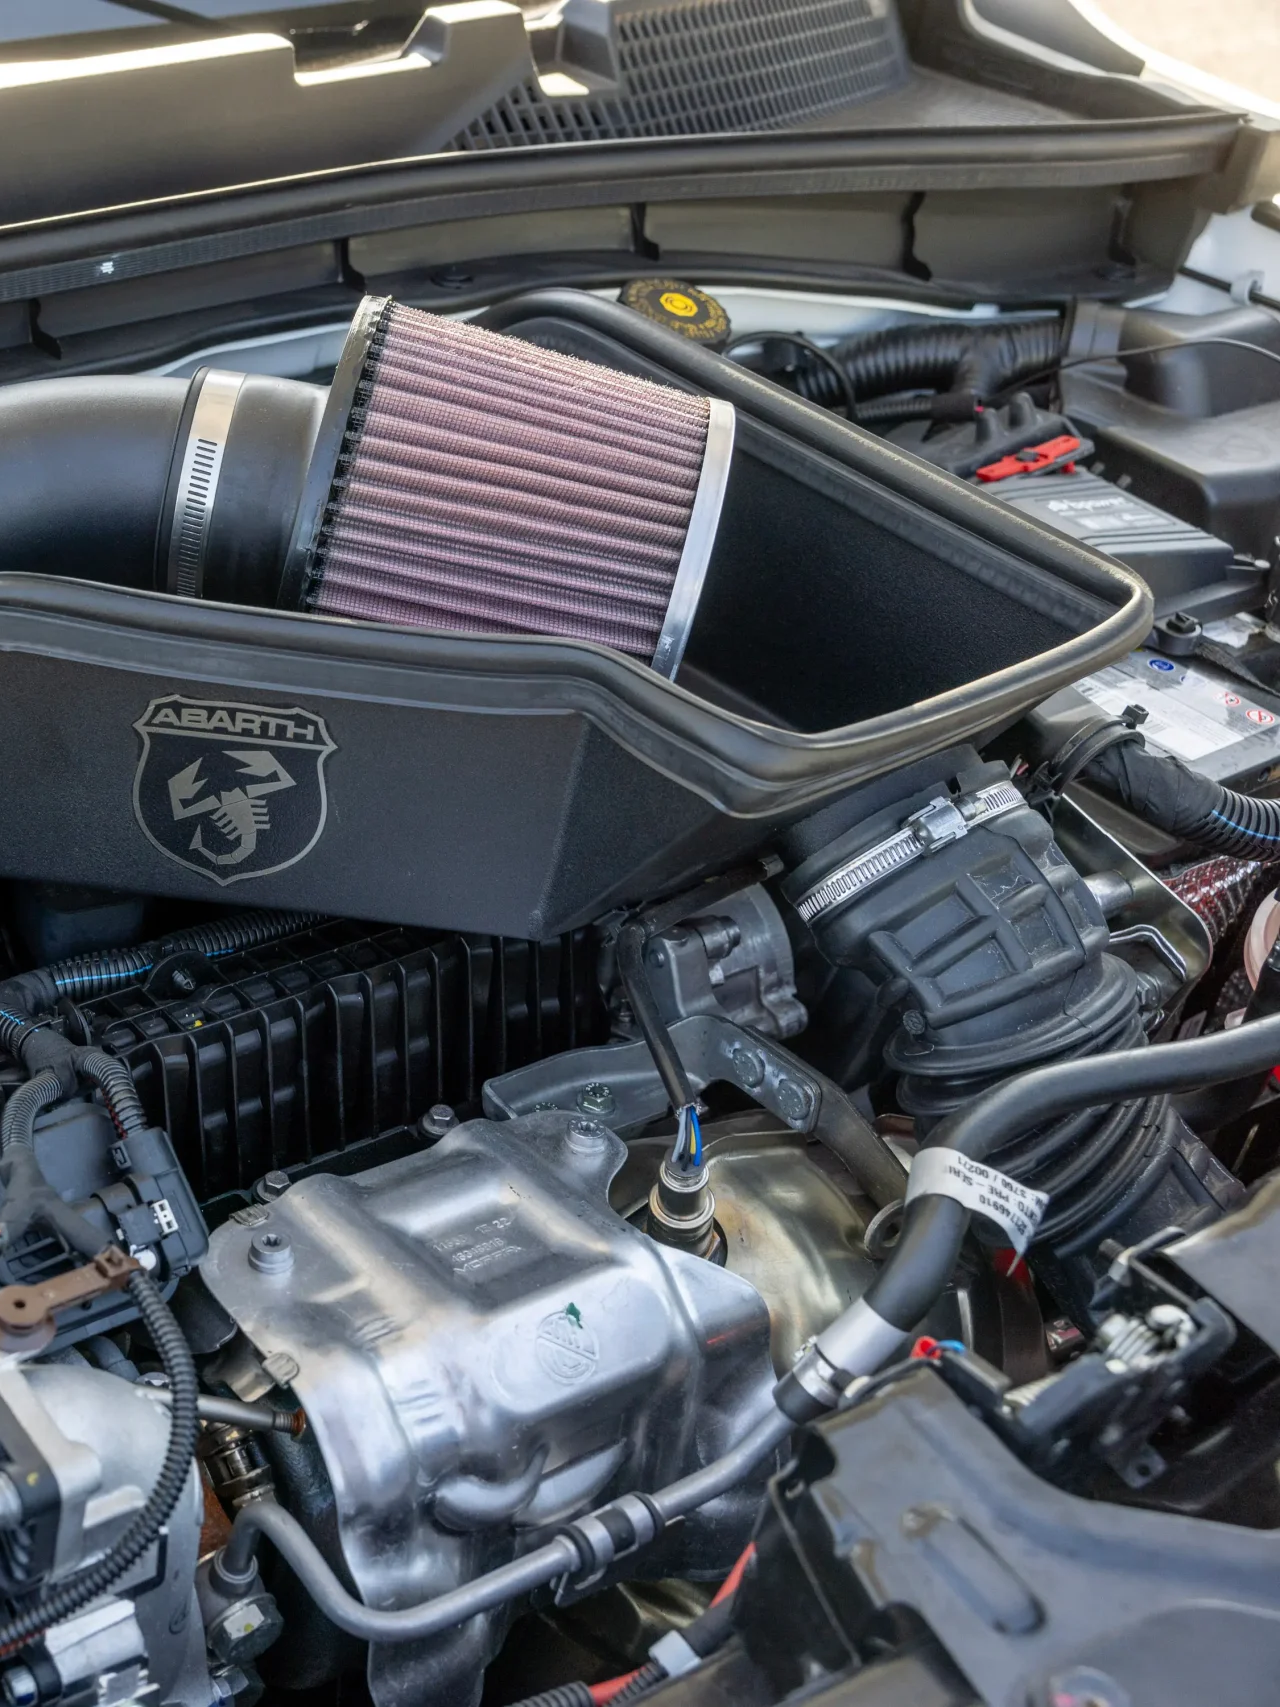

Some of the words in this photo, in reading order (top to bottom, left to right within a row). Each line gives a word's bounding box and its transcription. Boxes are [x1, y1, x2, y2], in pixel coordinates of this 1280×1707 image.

[151, 708, 315, 741] ABARTH
[957, 1154, 989, 1180] 00271
[987, 1184, 1011, 1203] PRE
[492, 1217, 512, 1229] 22
